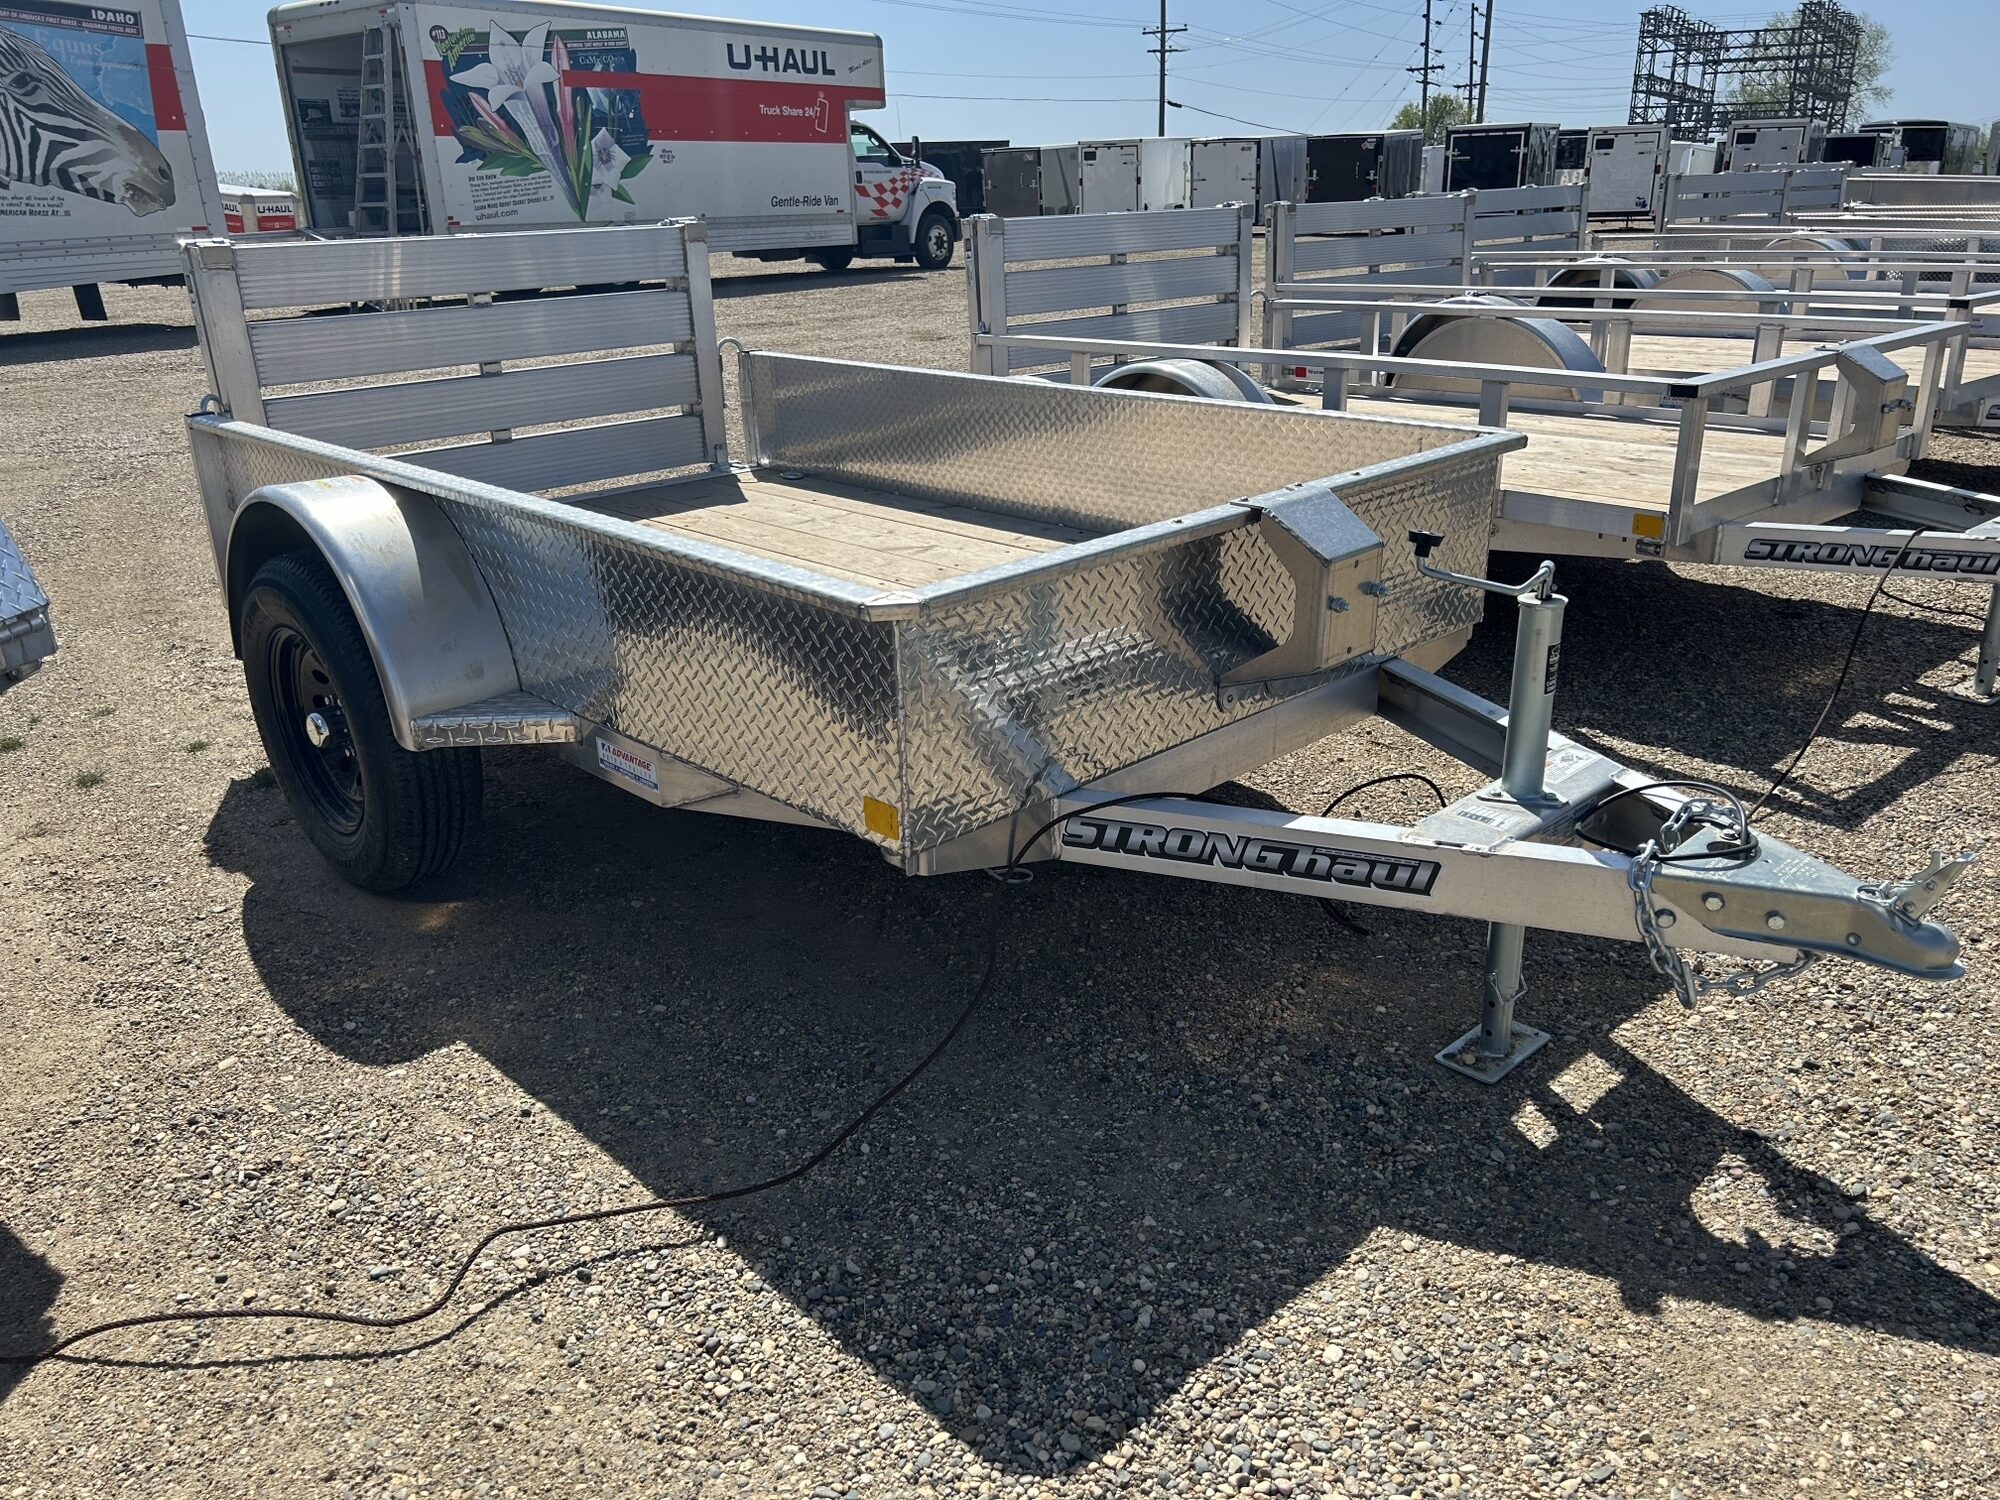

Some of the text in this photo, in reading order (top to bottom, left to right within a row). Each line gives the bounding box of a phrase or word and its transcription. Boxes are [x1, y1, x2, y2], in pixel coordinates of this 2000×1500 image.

[91, 9, 135, 25] IDAHO
[586, 30, 626, 40] ALABAMA
[726, 43, 836, 76] U-HAUL
[759, 104, 821, 118] Truck Share 24/7
[770, 195, 839, 207] Gentle-Ride Van
[257, 205, 293, 213] U-HAUL
[476, 209, 519, 221] uhaul.com
[1744, 539, 2000, 575] STRONG haul
[612, 747, 652, 771] ADVANTAGE
[1063, 816, 1442, 897] STRONG haul
